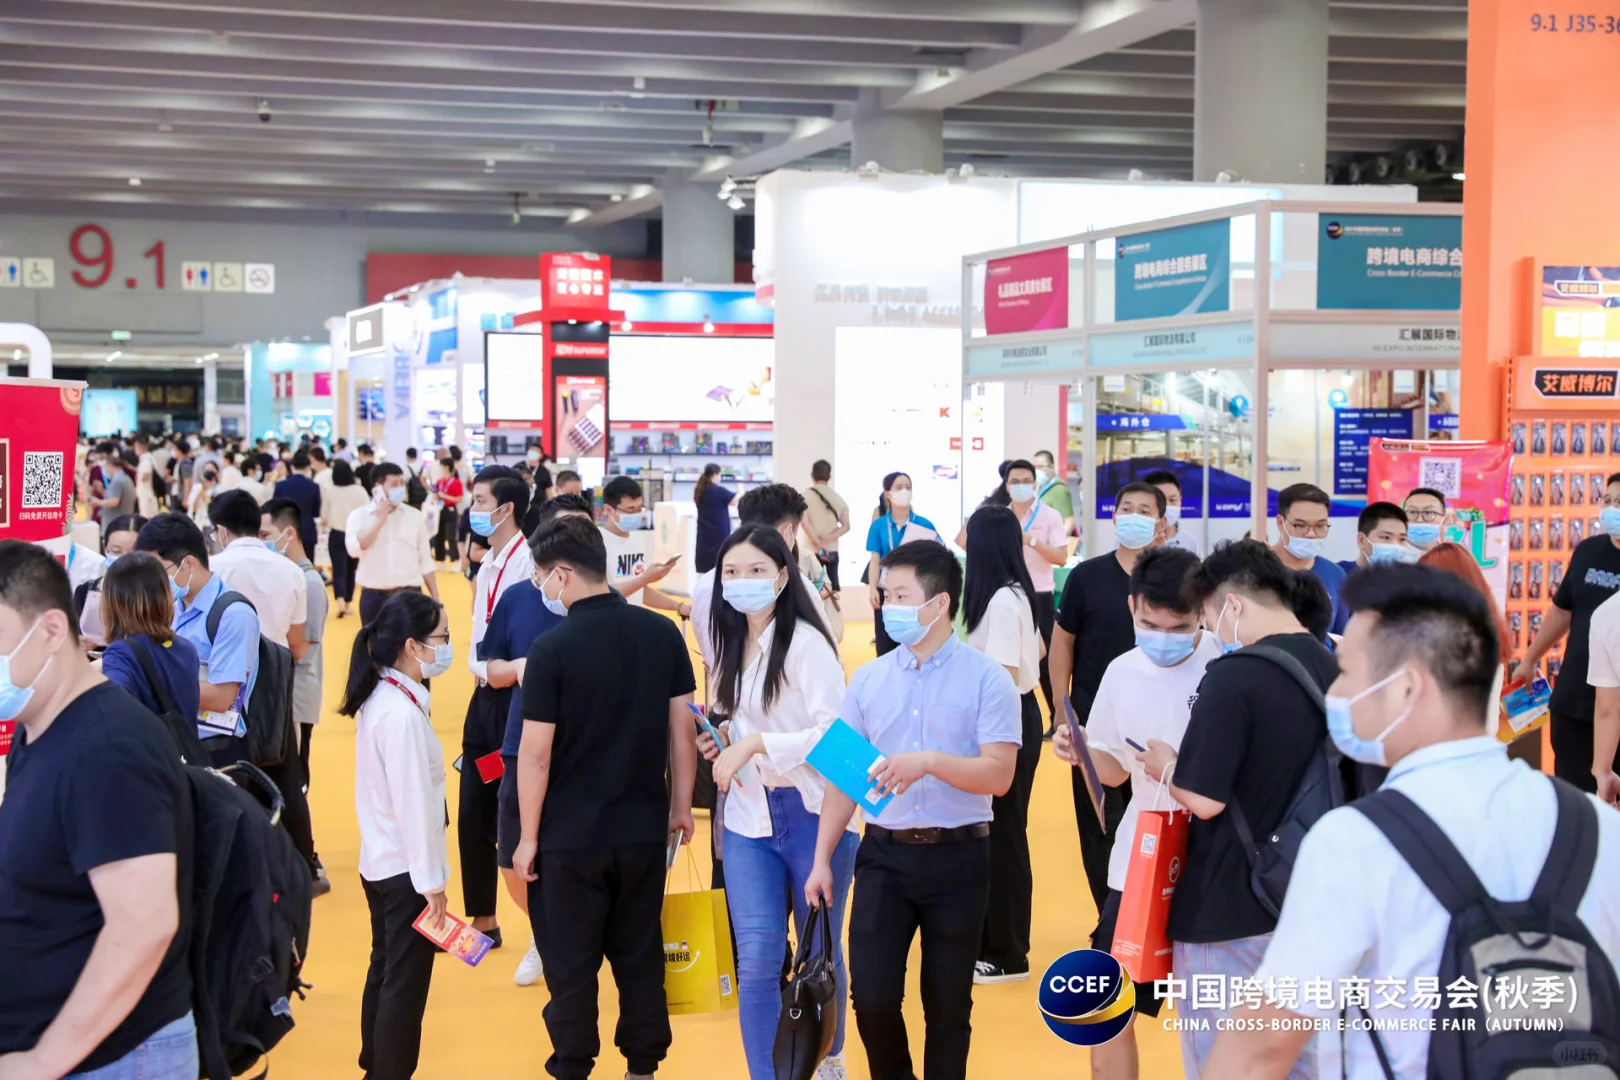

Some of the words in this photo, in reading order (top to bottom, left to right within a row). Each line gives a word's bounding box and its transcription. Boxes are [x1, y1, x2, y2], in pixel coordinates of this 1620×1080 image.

[1530, 14, 1558, 32] 9.1
[69, 223, 165, 289] 9.1
[1366, 247, 1462, 266] 跨境电商综合
[1542, 374, 1614, 393] 艾威博尔
